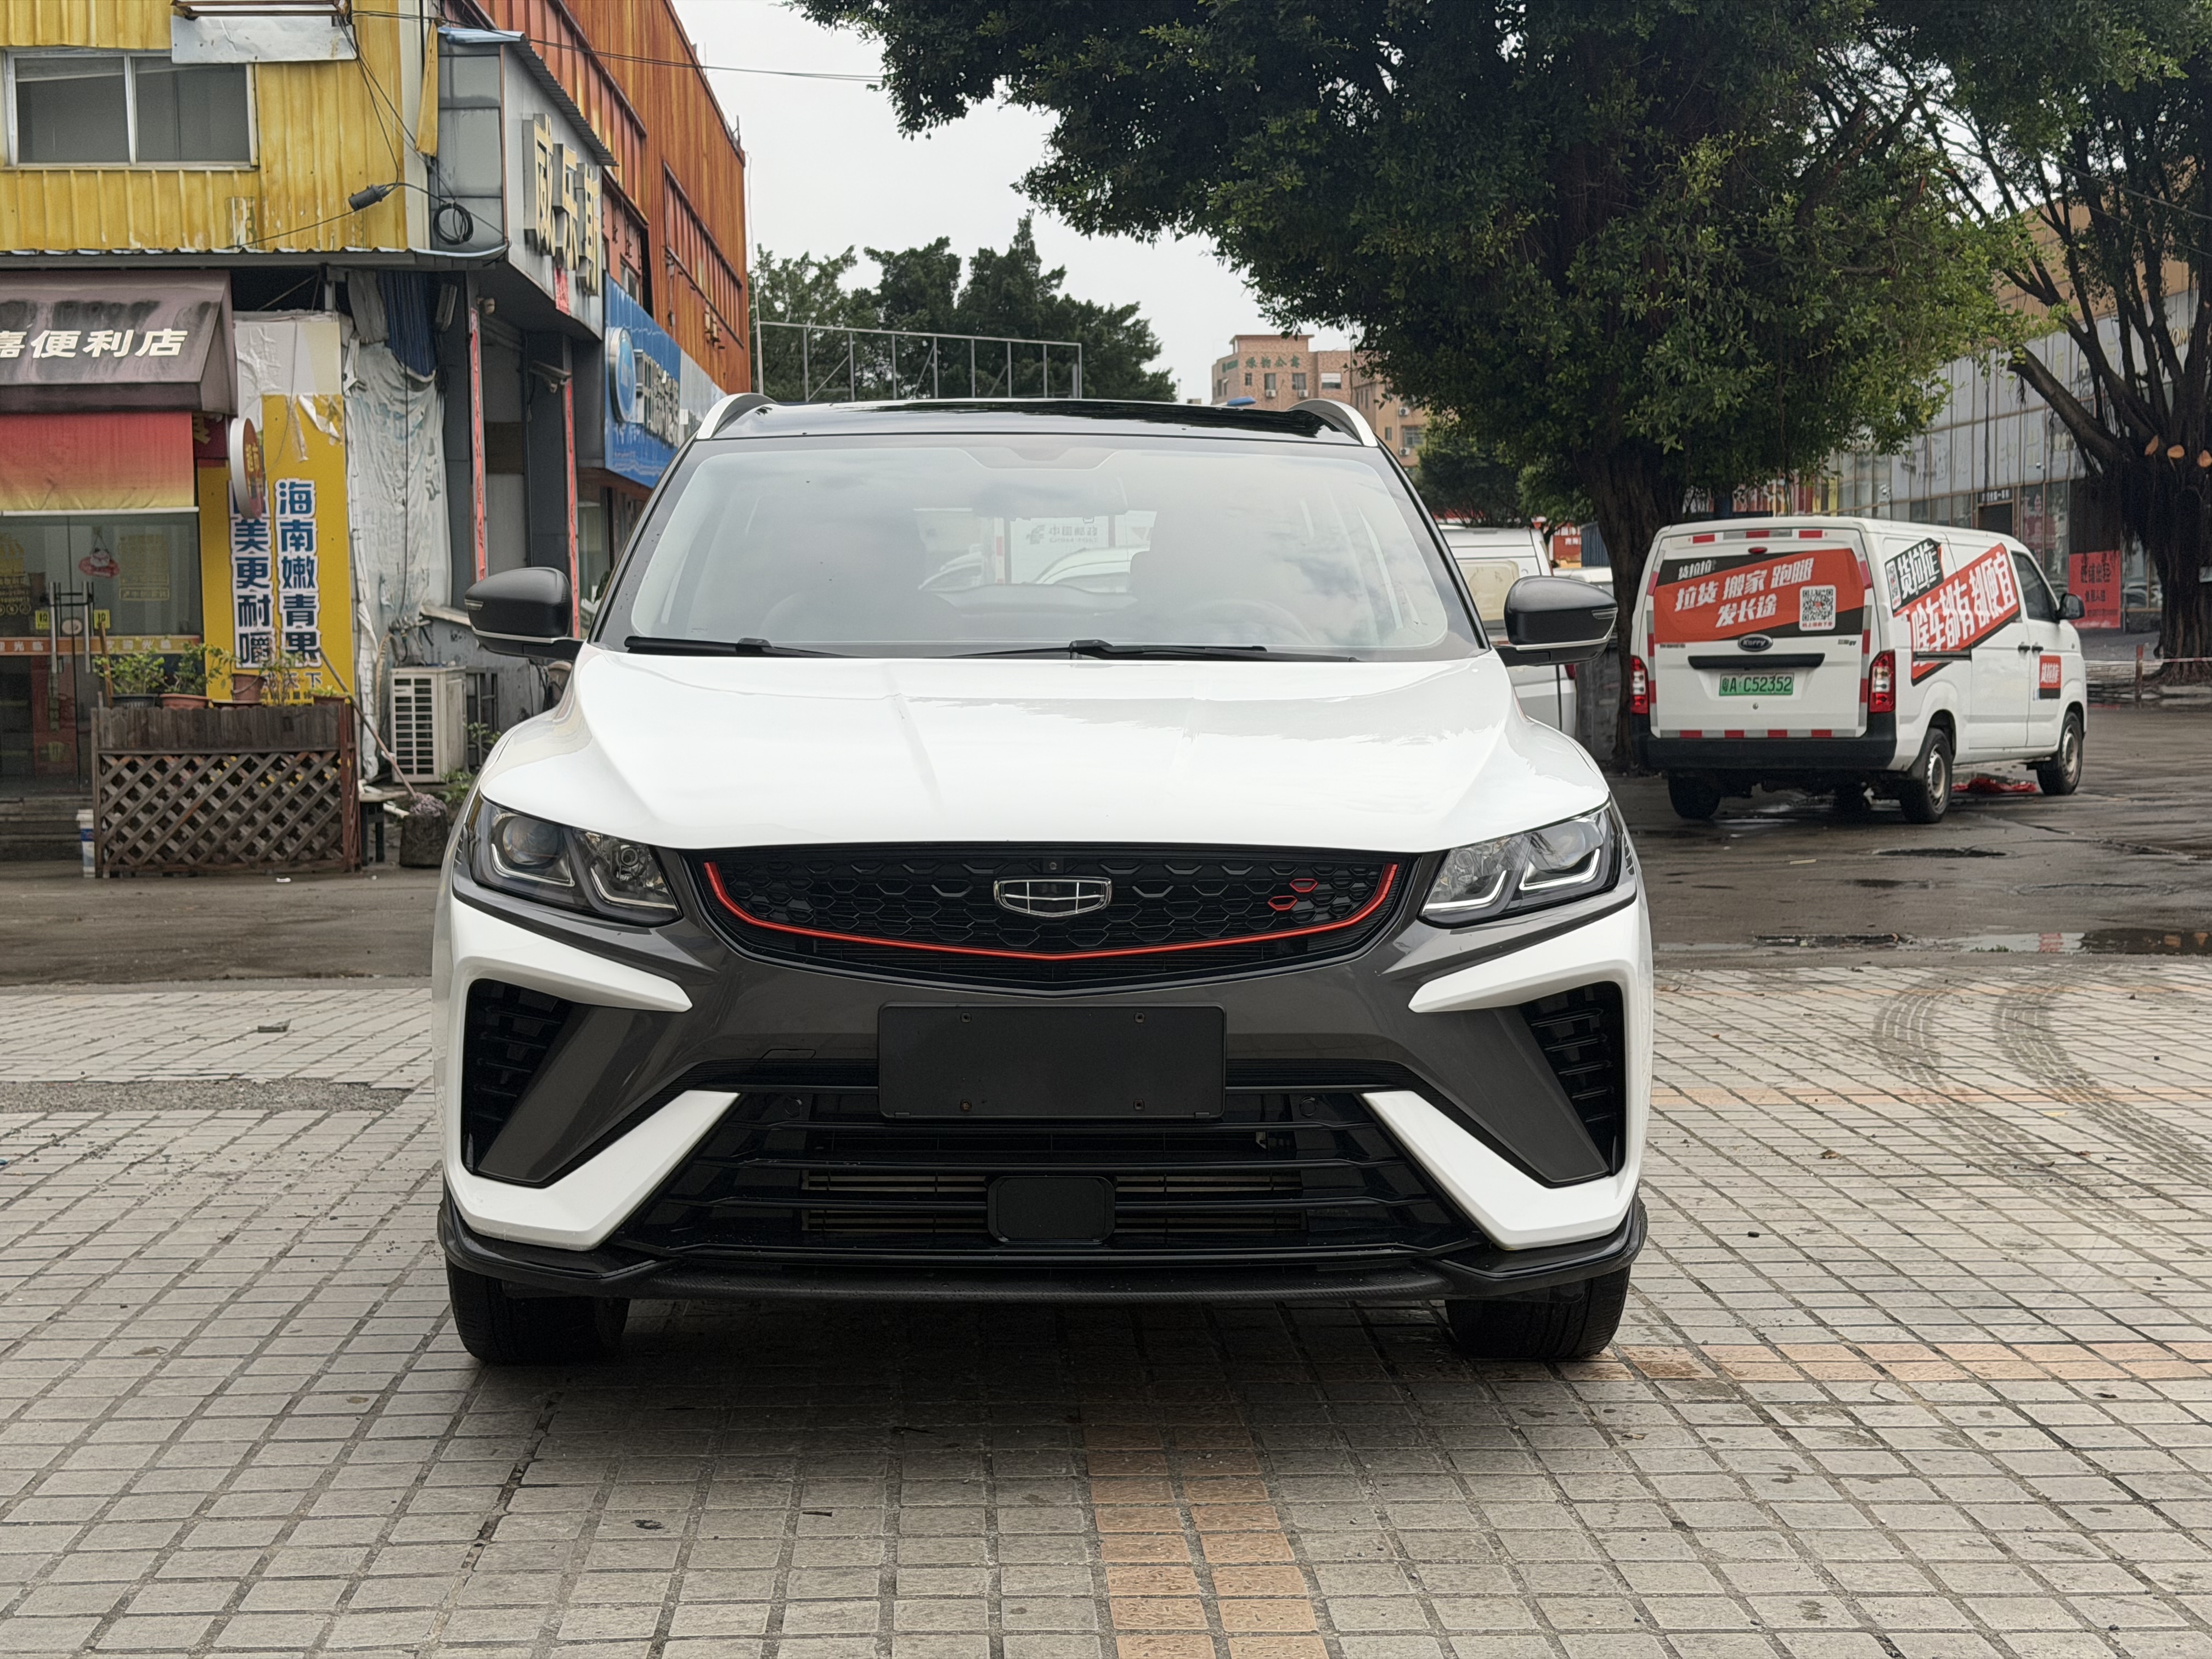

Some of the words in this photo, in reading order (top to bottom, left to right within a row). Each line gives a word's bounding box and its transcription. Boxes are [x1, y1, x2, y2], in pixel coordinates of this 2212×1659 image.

[0, 329, 188, 358] 嘉便利店
[232, 483, 272, 665] 美更耐嚼
[1675, 581, 1718, 612] 拉货
[1723, 569, 1767, 600] 搬家
[1770, 557, 1814, 589] 跑腿
[1716, 593, 1777, 628] 发长途
